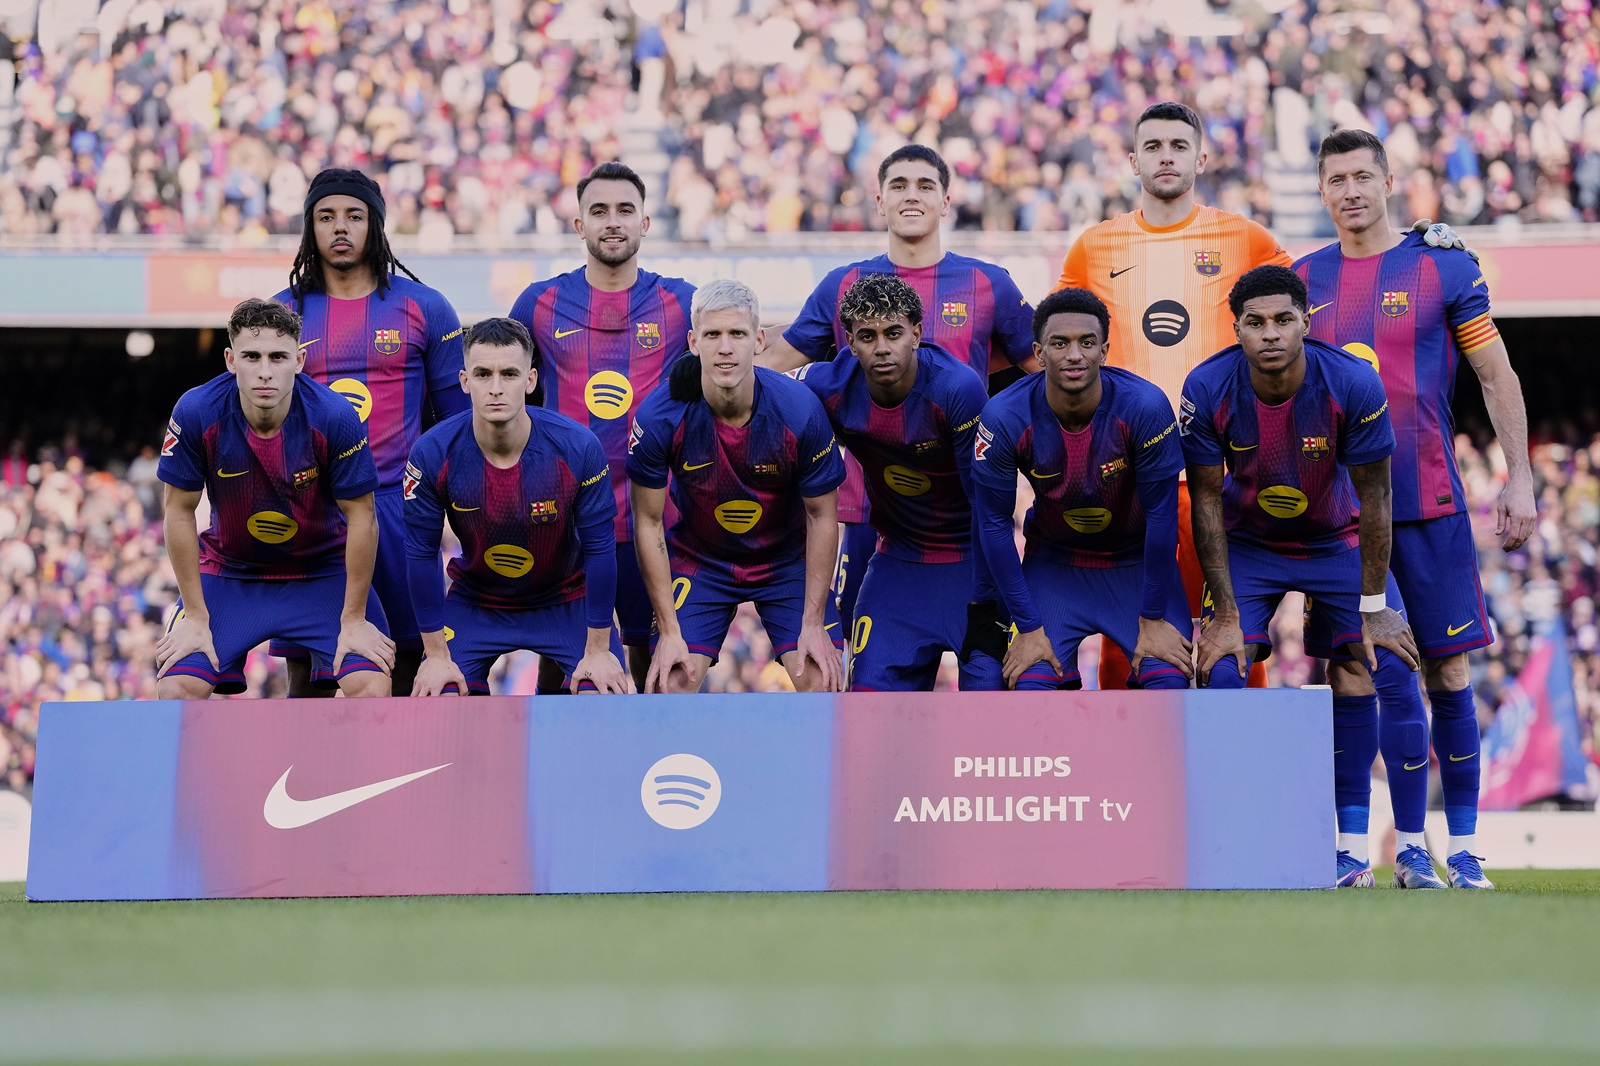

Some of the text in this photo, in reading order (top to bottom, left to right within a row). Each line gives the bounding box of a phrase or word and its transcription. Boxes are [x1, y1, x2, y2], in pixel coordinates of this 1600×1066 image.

[954, 756, 1072, 778] PHILIPS
[893, 795, 1133, 822] AMBILIGHT tv
